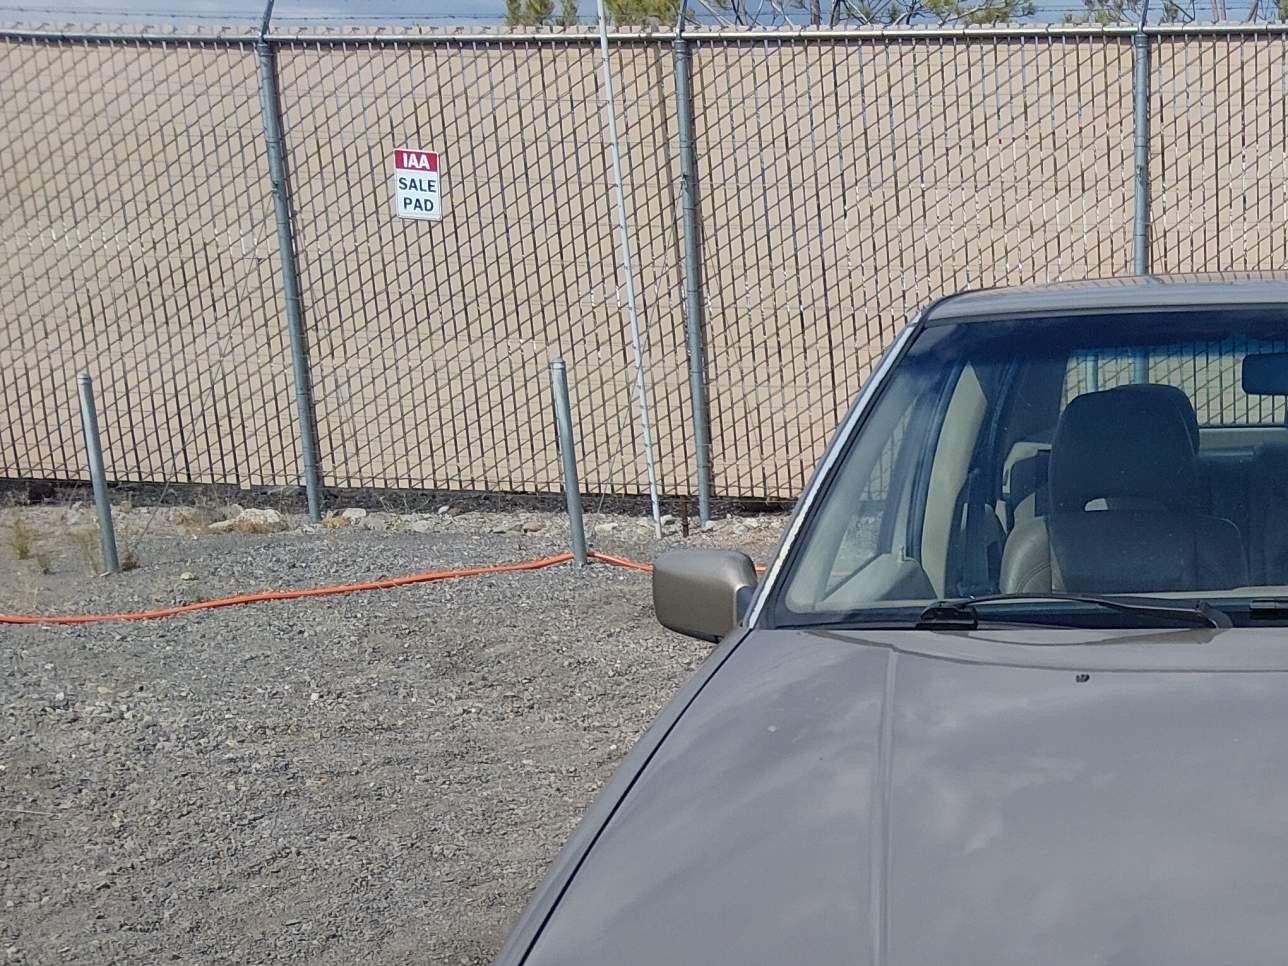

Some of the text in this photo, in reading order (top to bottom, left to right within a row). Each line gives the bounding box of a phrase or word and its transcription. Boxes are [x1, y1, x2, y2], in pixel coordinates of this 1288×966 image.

[402, 152, 431, 170] IAA
[398, 177, 436, 193] SALE
[403, 196, 434, 212] PAD
